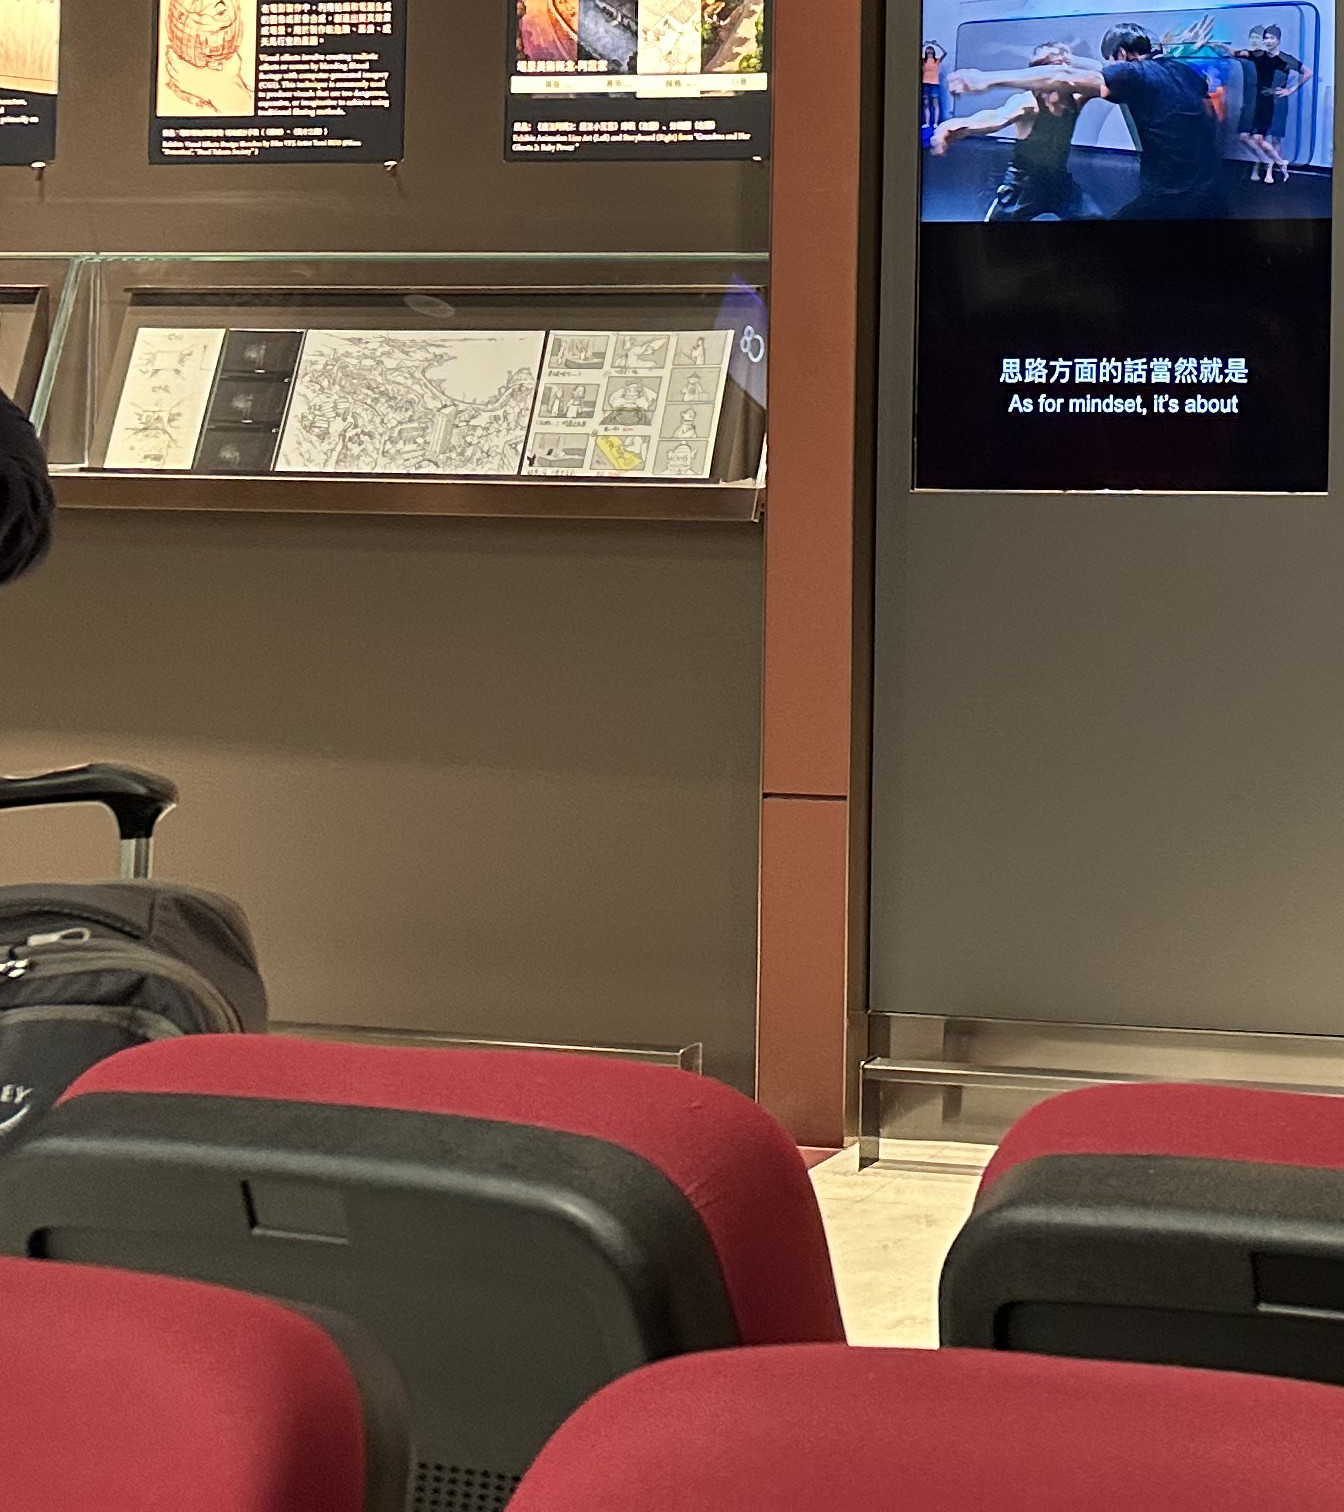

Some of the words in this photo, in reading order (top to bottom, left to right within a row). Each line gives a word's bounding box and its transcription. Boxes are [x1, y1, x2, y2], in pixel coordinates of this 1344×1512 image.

[1000, 357, 1249, 384] 思路方面的話當然就是
[1008, 394, 1033, 412] As
[1038, 394, 1065, 412] for
[1069, 394, 1147, 416] mindset,
[1185, 395, 1239, 413] about
